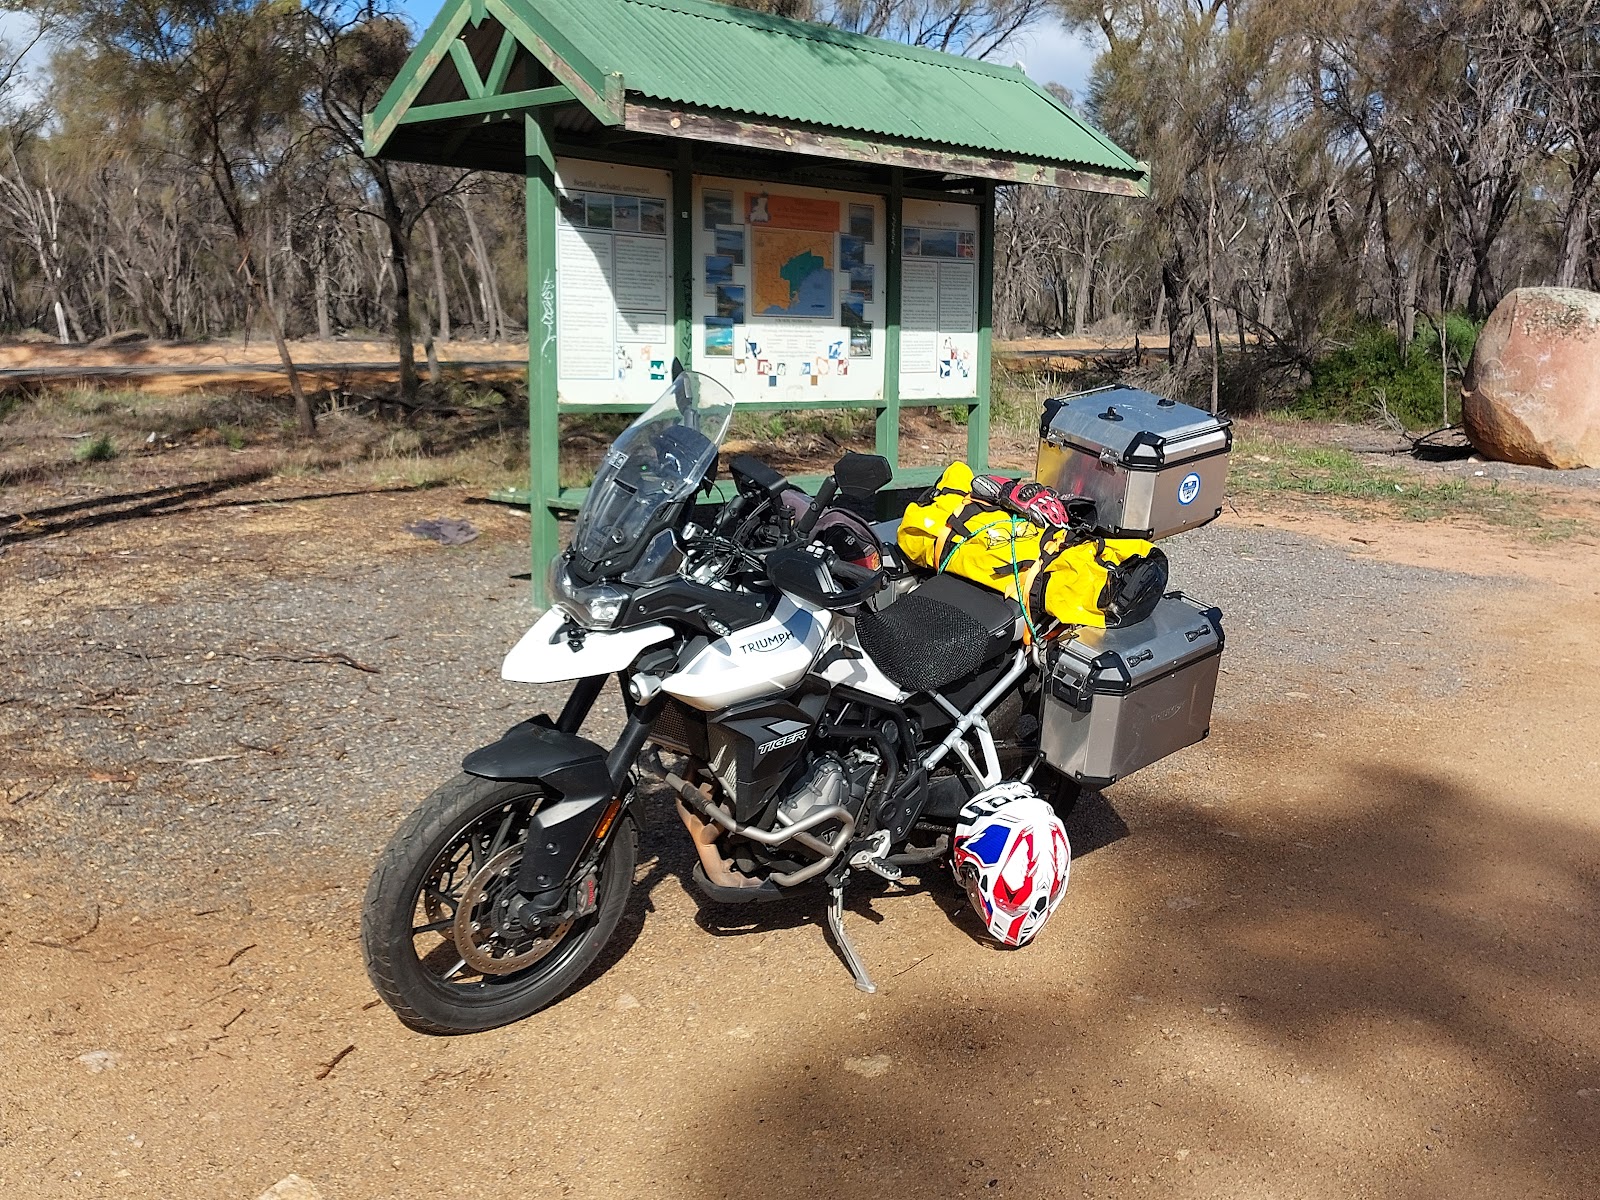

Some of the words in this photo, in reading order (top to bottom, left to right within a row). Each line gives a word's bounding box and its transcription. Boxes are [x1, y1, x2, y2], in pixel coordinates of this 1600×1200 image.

[844, 535, 855, 546] 18
[739, 630, 795, 654] TRIUMPH
[757, 729, 807, 755] TIGER
